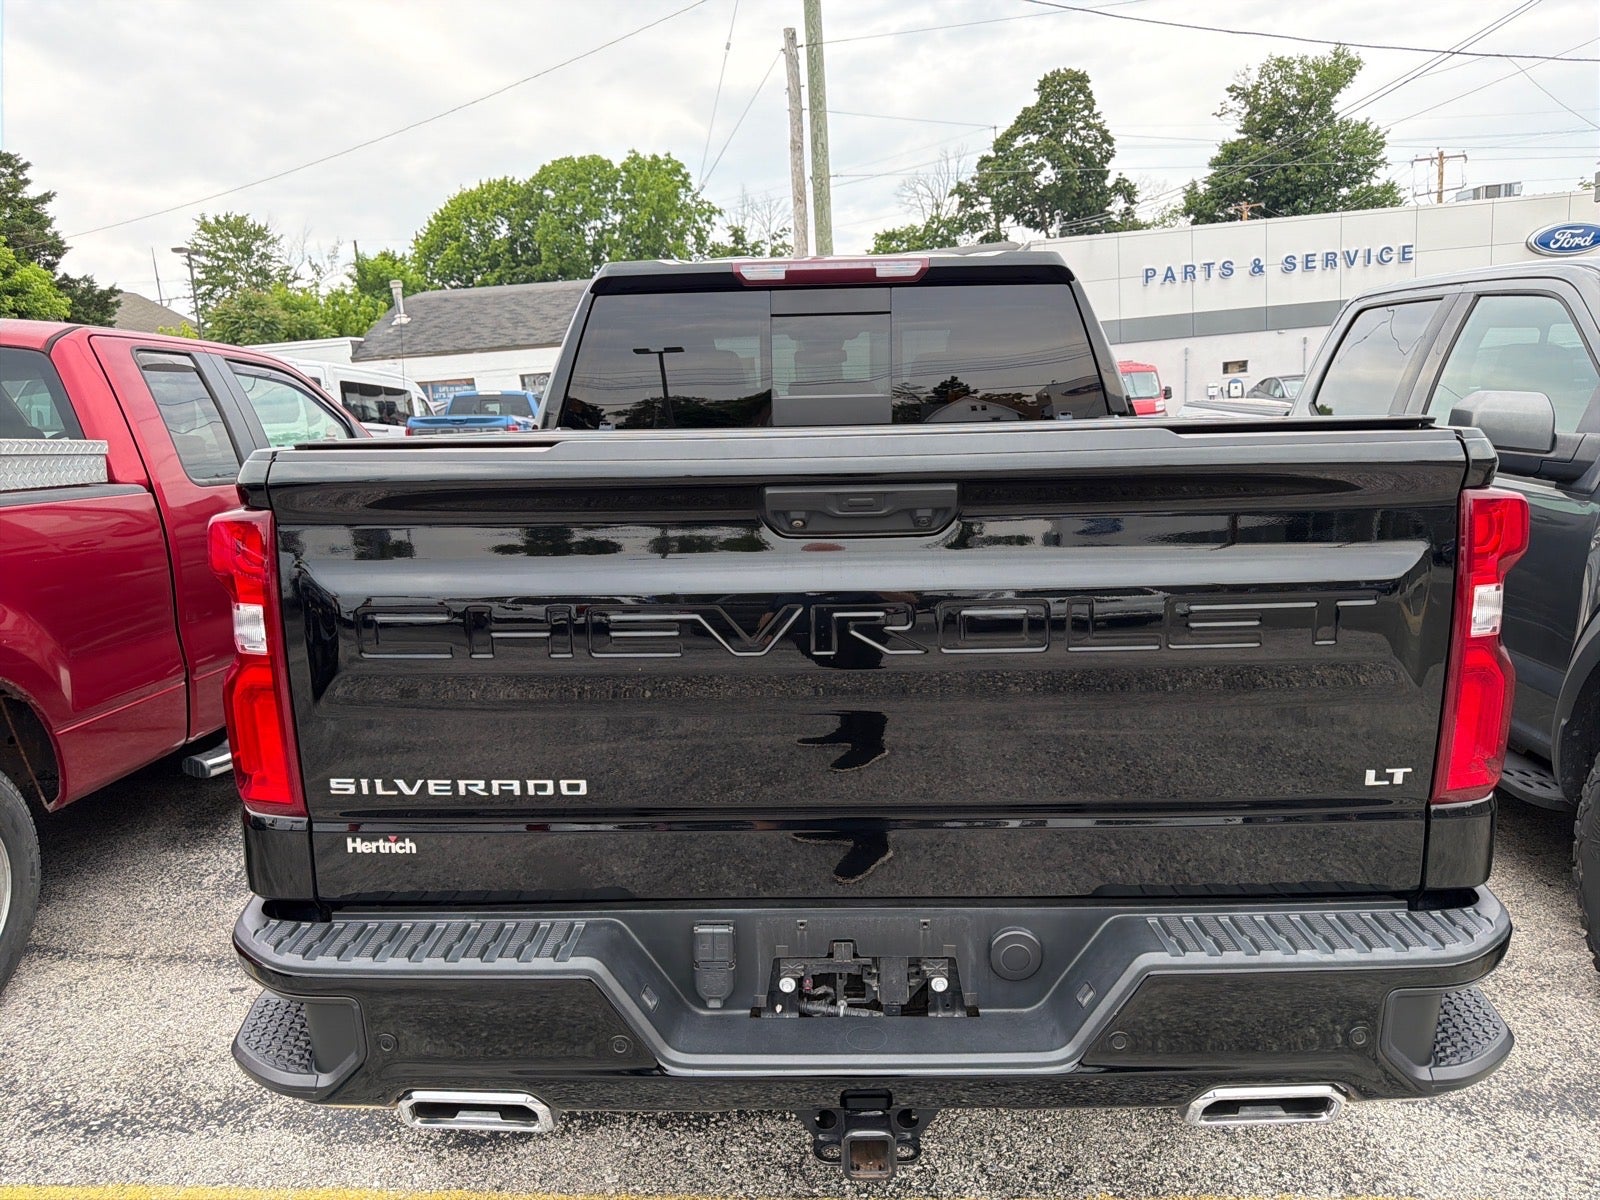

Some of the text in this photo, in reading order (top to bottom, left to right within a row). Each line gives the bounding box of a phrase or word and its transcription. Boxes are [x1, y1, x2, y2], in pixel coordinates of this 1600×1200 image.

[1550, 229, 1595, 249] Ford
[1143, 244, 1414, 285] PARTS & SERVICE
[353, 592, 1379, 659] CHEVROLET
[1364, 767, 1413, 786] LT
[329, 778, 588, 796] SILVERADO
[346, 836, 417, 854] Hertrich
